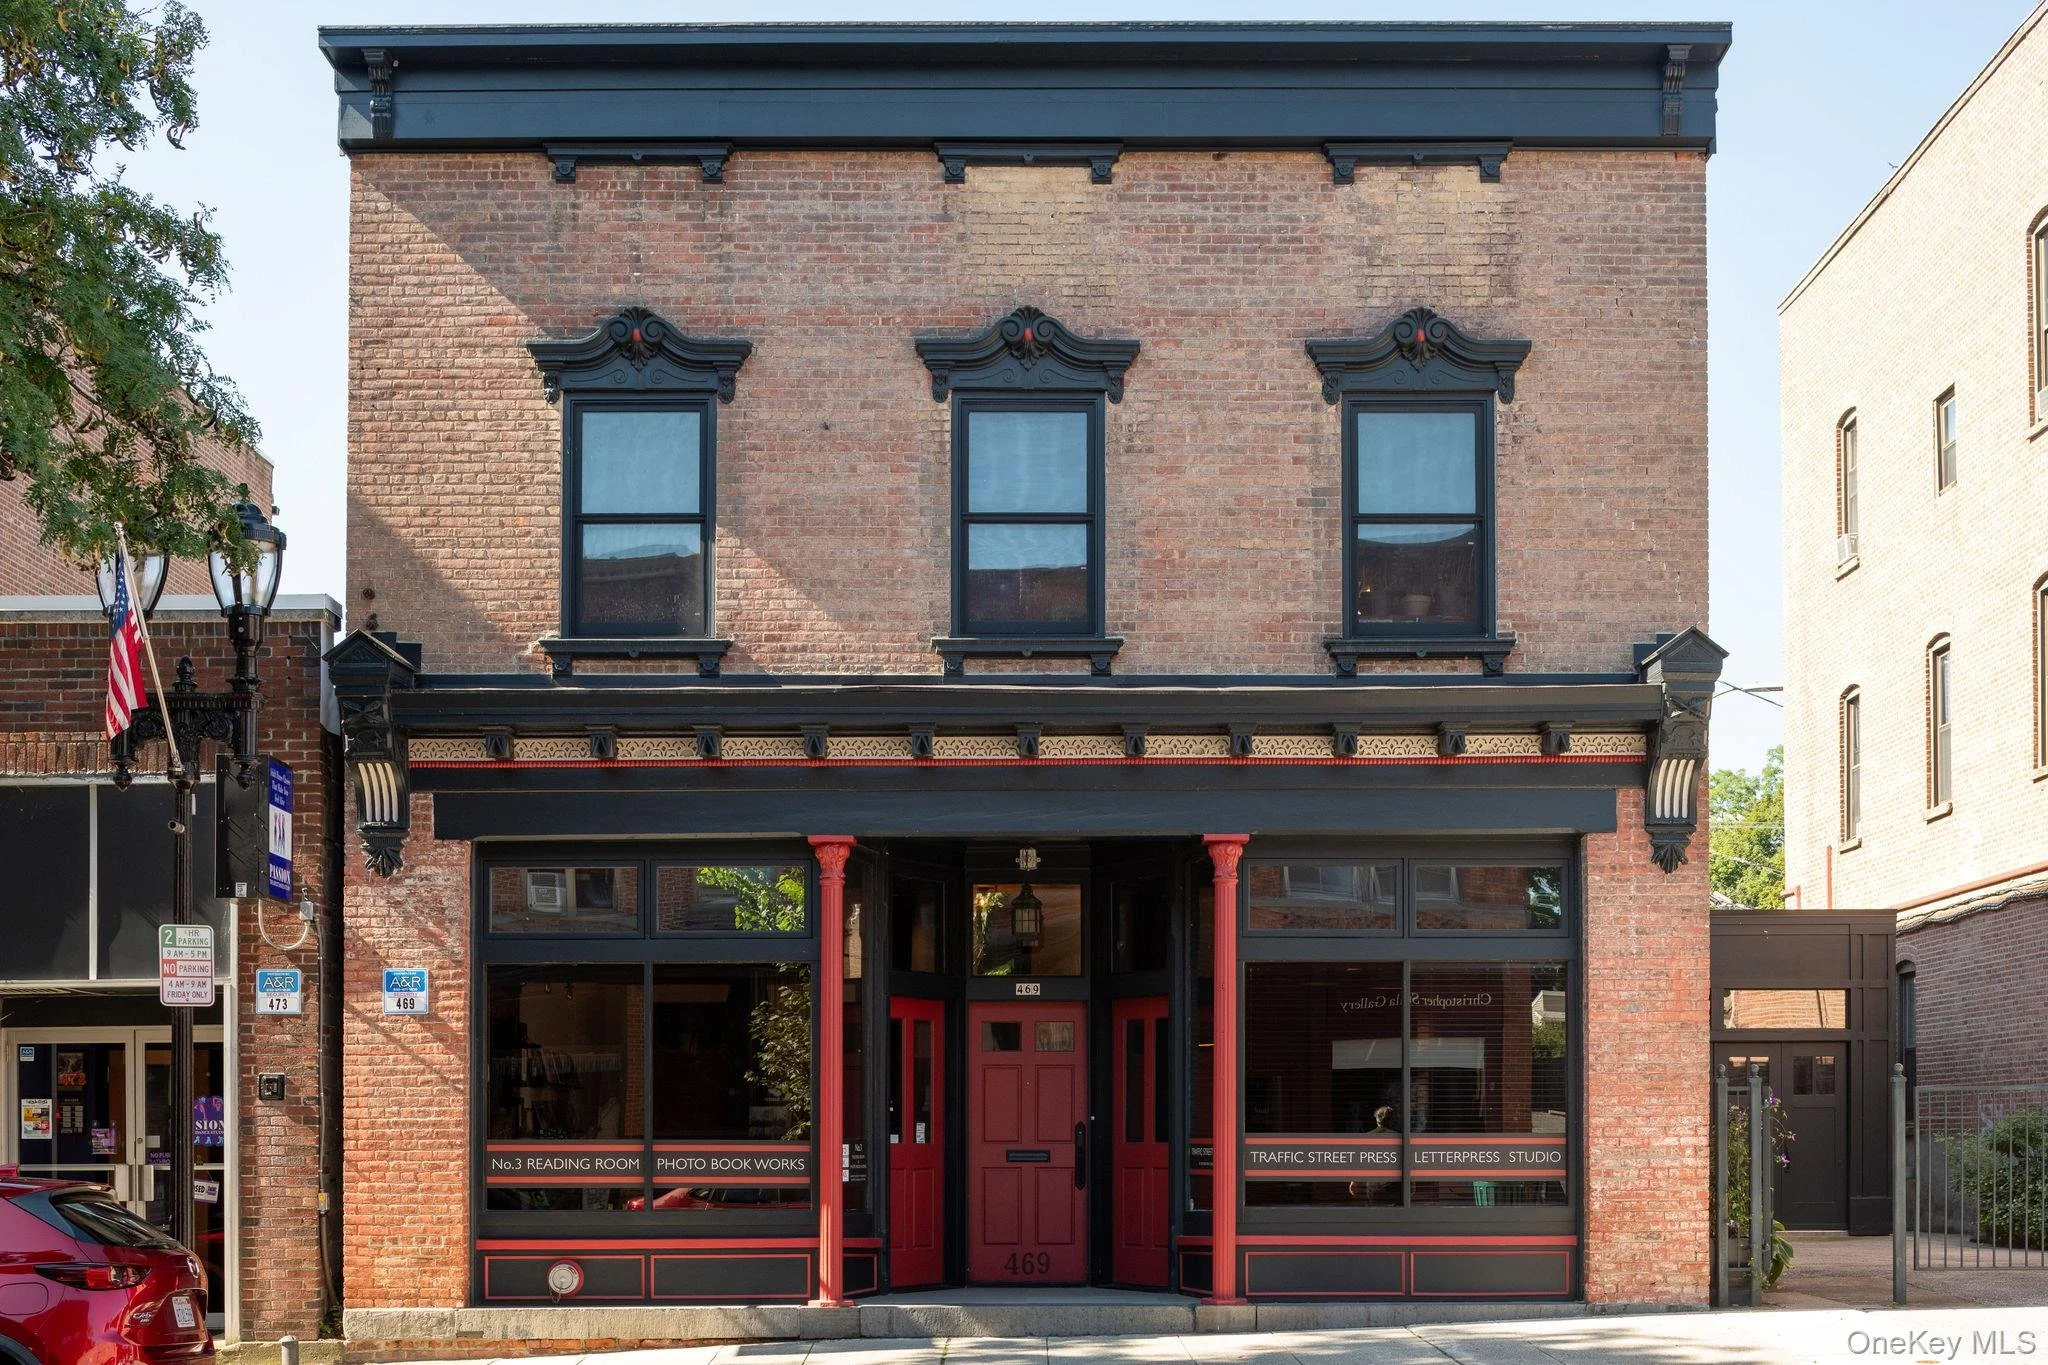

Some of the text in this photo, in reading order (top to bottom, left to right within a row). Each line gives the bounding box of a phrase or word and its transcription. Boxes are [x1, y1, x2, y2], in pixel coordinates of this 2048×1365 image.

[164, 929, 173, 945] 2
[188, 929, 200, 937] HR
[178, 937, 209, 946] PARKING
[190, 950, 195, 958] 5
[197, 950, 207, 958] PM
[163, 963, 210, 975] NO PARKING
[168, 980, 173, 988] 4
[175, 980, 185, 988] AM
[190, 980, 195, 988] 9
[196, 980, 207, 988] AM
[262, 976, 295, 989] A&R
[390, 976, 421, 988] A&R
[167, 990, 191, 998] FRIDAY
[1017, 984, 1039, 995] 469
[268, 998, 288, 1010] 473
[396, 997, 415, 1010] 469
[1250, 1151, 1397, 1163] TRAFFIC STREET PRESS
[1414, 1151, 1561, 1163] LETTERPRESS STUDIO
[492, 1158, 640, 1170] No.3 READING ROOM
[657, 1158, 805, 1170] PHOTO BOOK WORKS
[1004, 1252, 1050, 1275] 469
